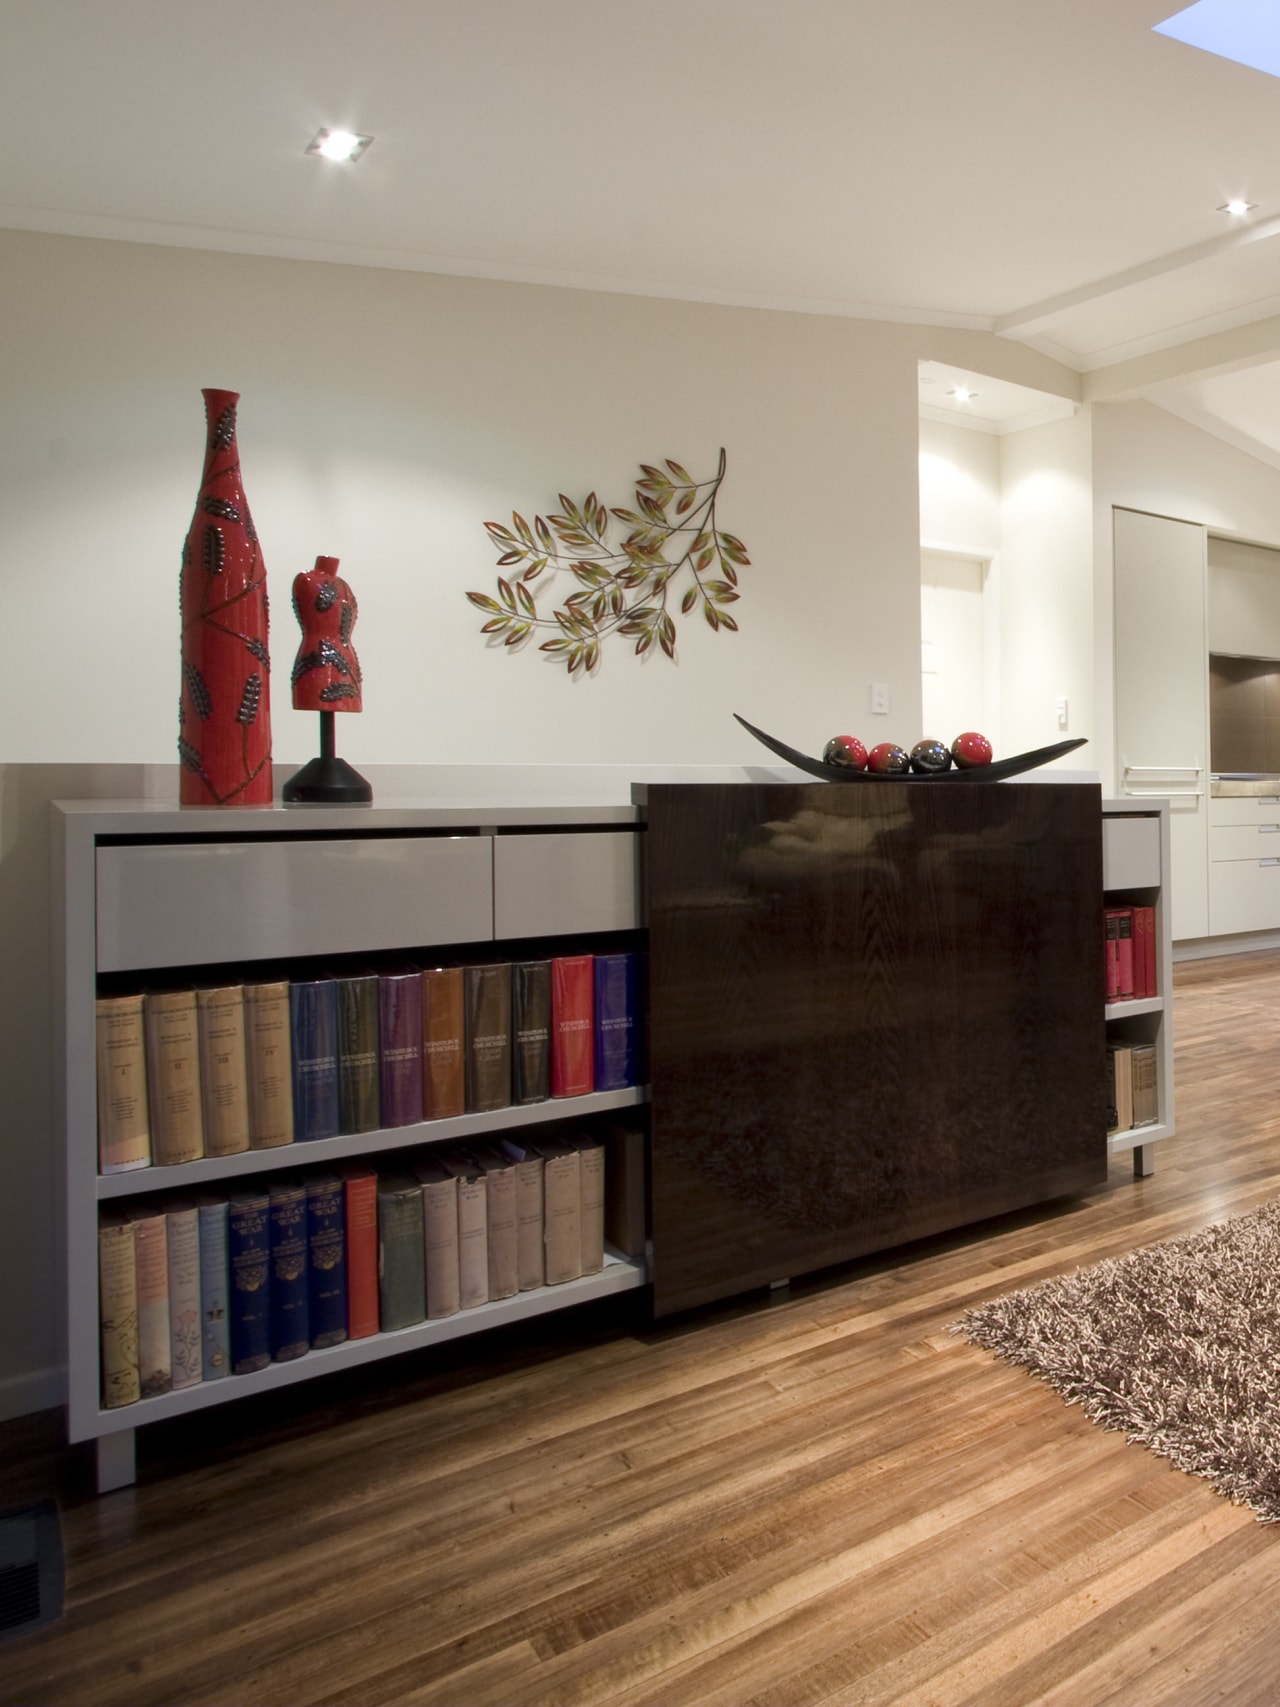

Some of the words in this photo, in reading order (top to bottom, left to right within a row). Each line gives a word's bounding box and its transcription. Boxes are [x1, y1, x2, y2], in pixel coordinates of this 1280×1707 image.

[308, 1197, 341, 1211] GREAT
[271, 1206, 305, 1220] GREAT
[314, 1206, 337, 1216] WAR
[232, 1215, 268, 1230] GREAT
[278, 1215, 301, 1226] WAR
[239, 1225, 263, 1236] WAR
